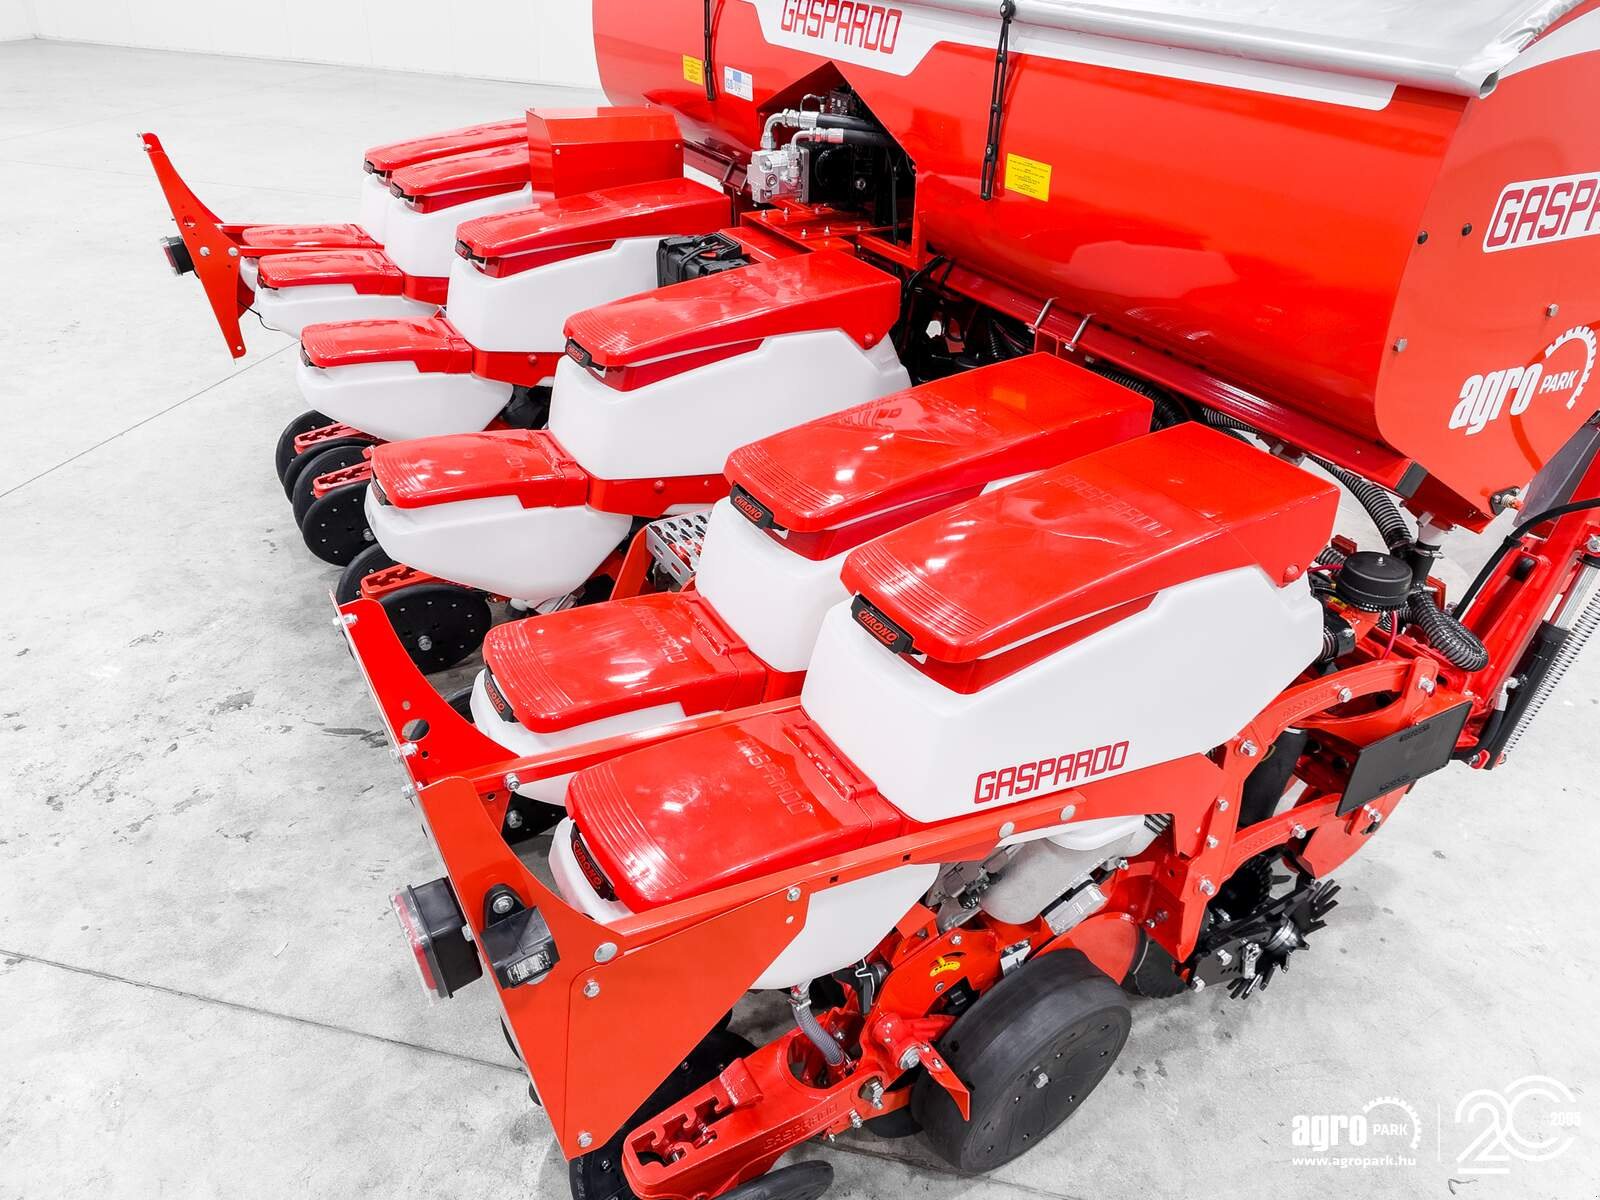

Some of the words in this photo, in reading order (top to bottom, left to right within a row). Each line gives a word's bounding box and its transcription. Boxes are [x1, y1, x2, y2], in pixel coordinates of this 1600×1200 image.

[781, 0, 902, 54] GASPARDO
[1448, 362, 1543, 436] agro
[1538, 369, 1579, 394] PARK
[858, 609, 898, 643] CHRONO
[974, 740, 1130, 804] GASPARDO
